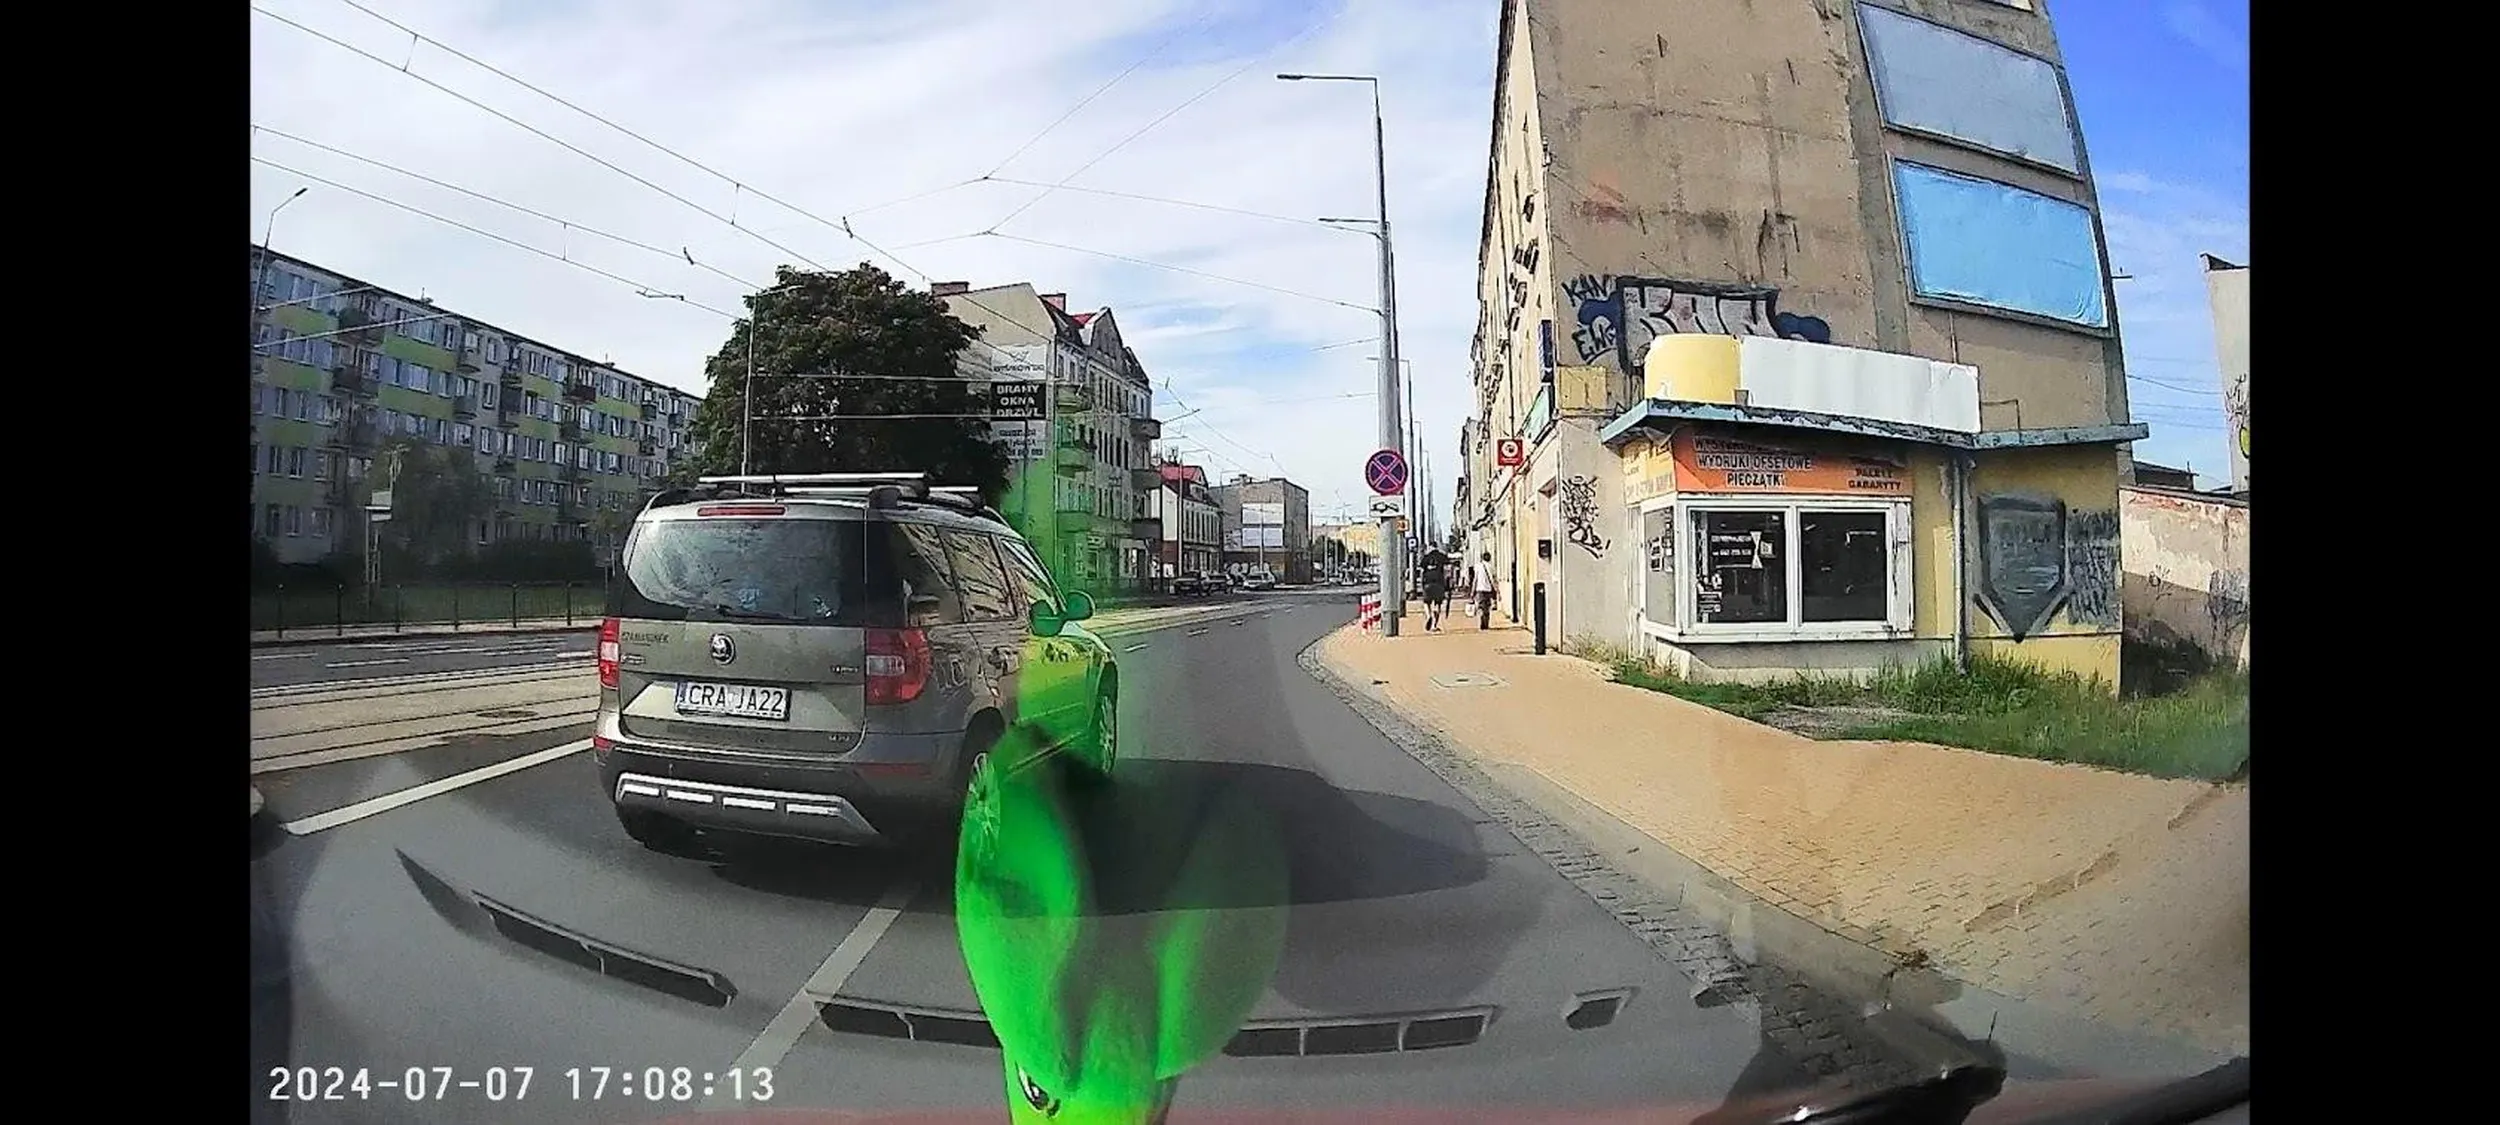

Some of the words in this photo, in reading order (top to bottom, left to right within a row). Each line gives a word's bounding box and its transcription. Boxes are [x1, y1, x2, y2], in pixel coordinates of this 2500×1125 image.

[1000, 396, 1035, 406] OKNA
[1697, 454, 1750, 469] WYDRUKI
[1753, 456, 1811, 470] OFSETOWE
[1726, 472, 1785, 488] PIECZĄTKI
[689, 685, 727, 707] CRA
[734, 688, 783, 712] JA22
